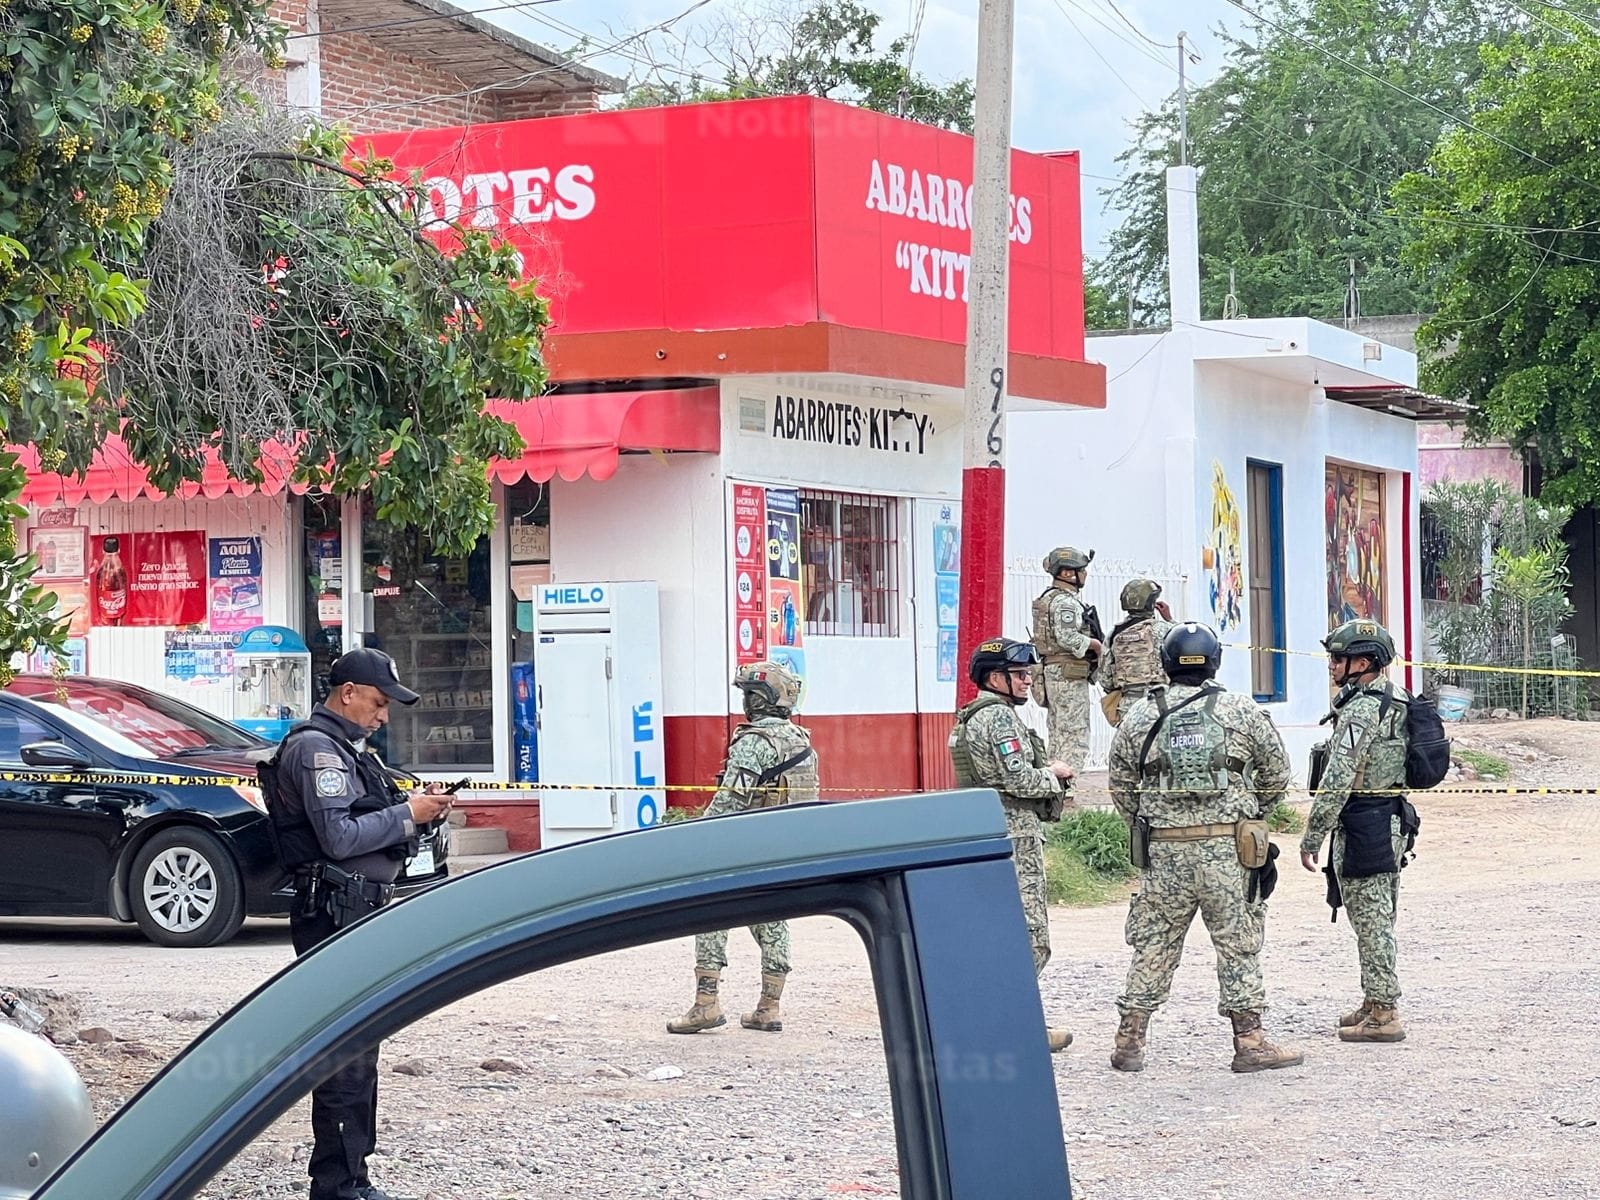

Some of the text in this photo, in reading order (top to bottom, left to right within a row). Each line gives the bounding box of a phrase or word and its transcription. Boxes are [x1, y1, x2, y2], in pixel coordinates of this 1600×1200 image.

[772, 394, 862, 448] ABARROTES
[141, 562, 160, 572] Zero
[138, 573, 162, 581] nueva
[130, 581, 157, 591] mismo
[373, 586, 401, 597] EMPUJE
[544, 587, 604, 605] HIELO
